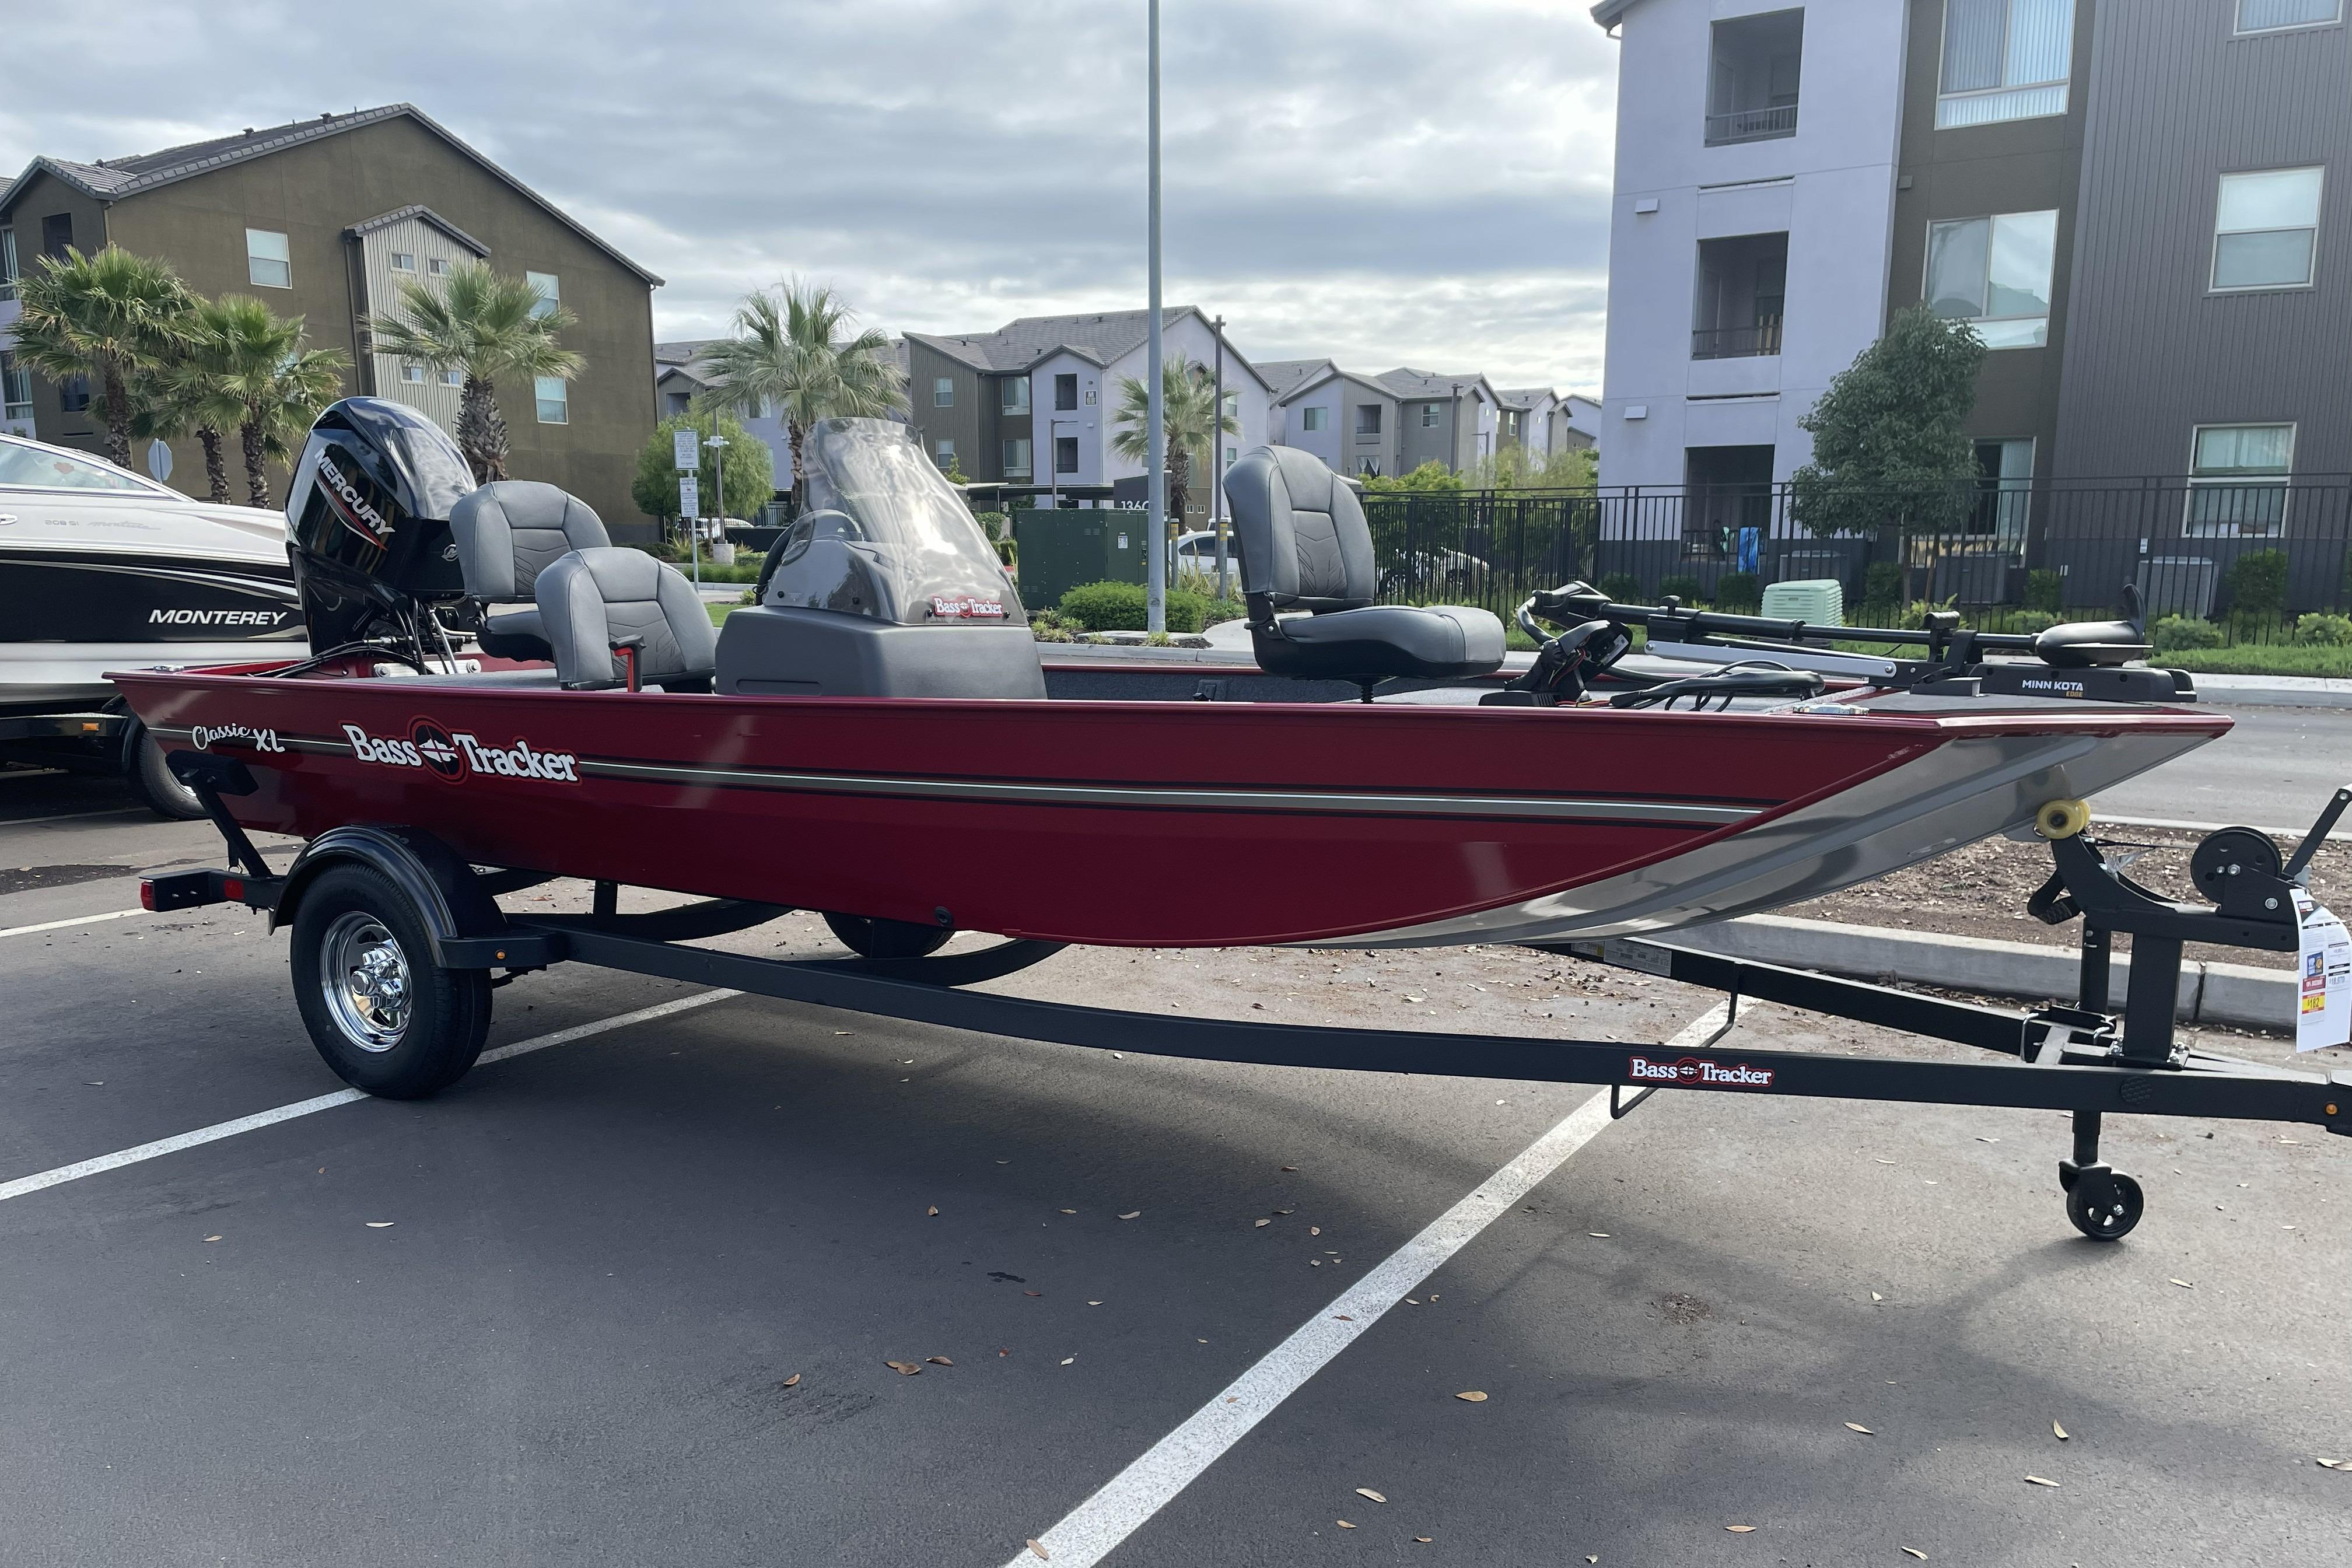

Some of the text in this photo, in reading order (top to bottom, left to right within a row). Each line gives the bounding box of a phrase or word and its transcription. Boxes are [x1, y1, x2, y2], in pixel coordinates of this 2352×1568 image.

[314, 448, 396, 535] MERCURY
[934, 597, 1003, 614] Bass Tracker
[148, 609, 288, 625] MONTEREY
[2022, 680, 2084, 691] MINN KOTA
[192, 723, 285, 752] Classic XL
[342, 725, 578, 781] Bass Tracker
[2307, 998, 2320, 1009] $182
[1632, 1059, 1772, 1084] Bass Tracker
